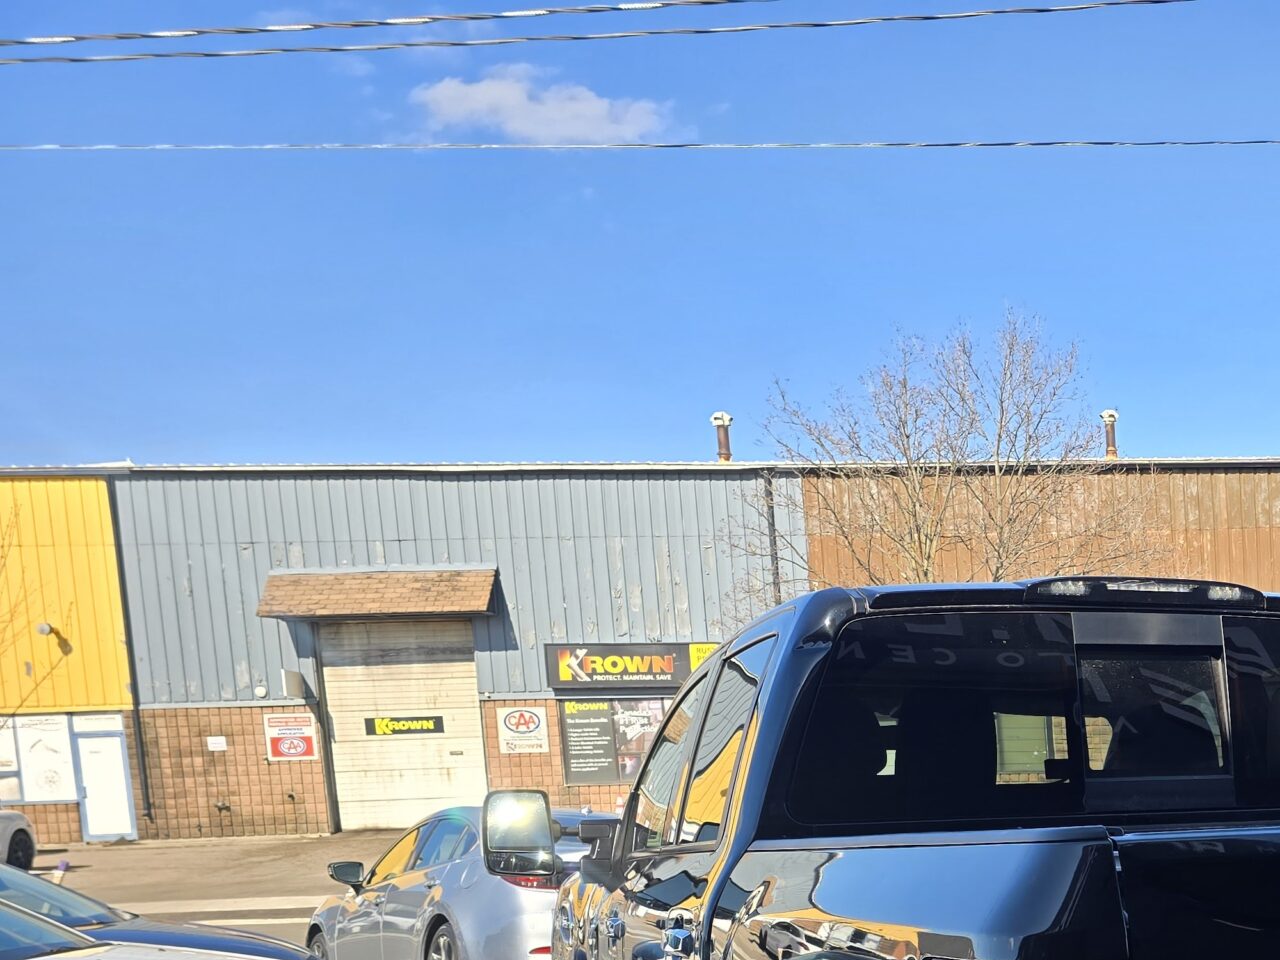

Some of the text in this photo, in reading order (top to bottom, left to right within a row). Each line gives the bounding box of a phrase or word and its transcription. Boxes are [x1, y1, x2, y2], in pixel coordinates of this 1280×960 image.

[558, 647, 674, 682] KROWN
[564, 701, 608, 714] KROWN
[374, 718, 434, 735] KROWN
[508, 712, 536, 730] CAA
[283, 740, 301, 752] CAA
